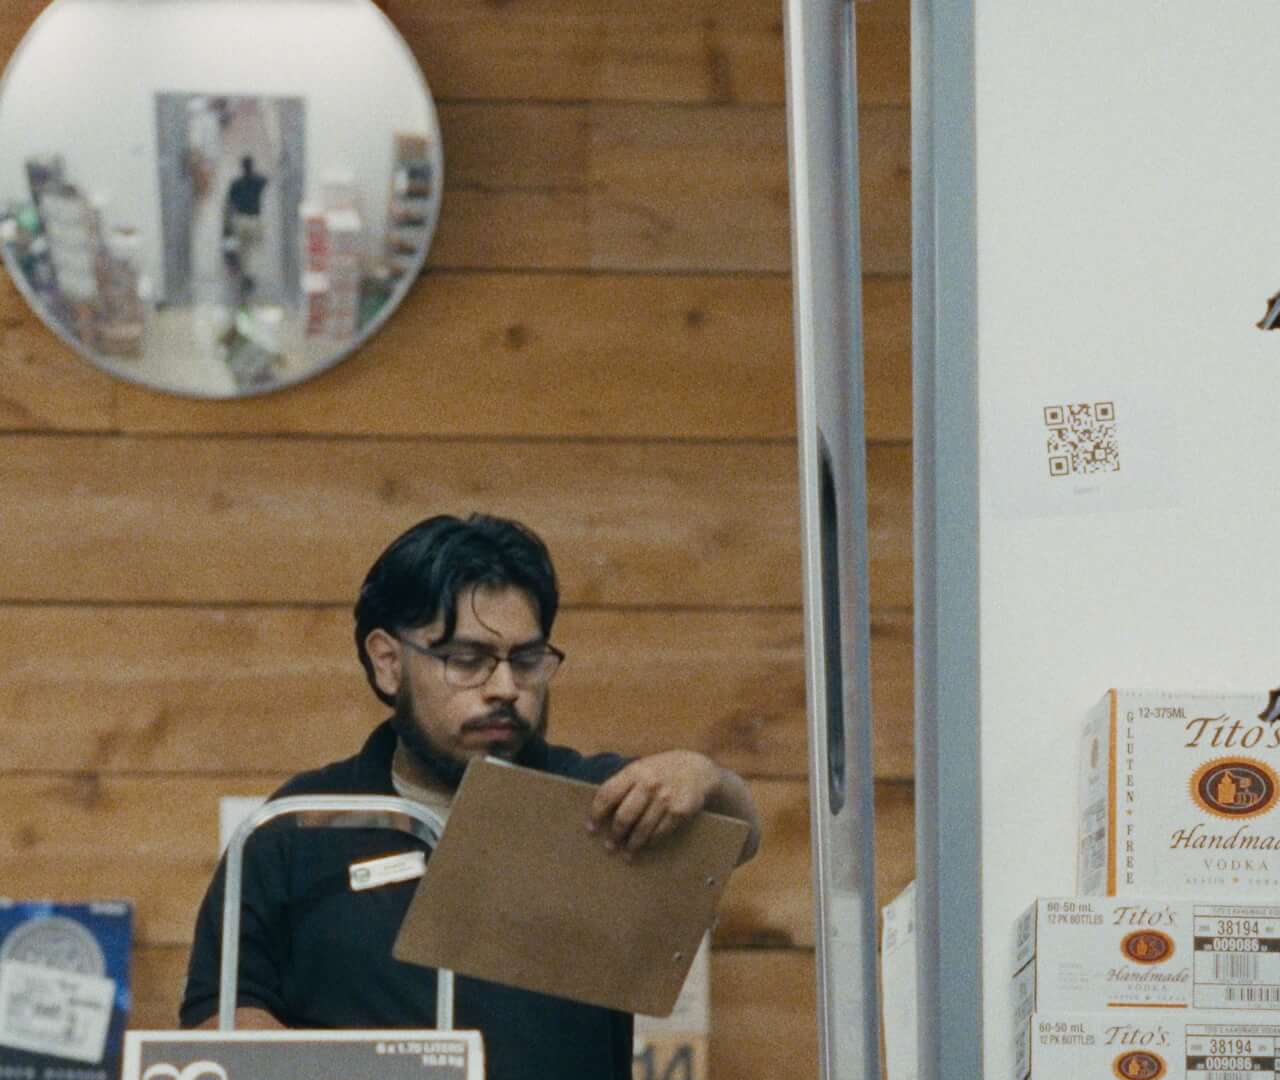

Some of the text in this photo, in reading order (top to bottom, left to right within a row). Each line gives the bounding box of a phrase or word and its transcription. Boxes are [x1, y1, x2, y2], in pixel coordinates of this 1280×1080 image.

[1138, 707, 1186, 719] 12-375ML
[1126, 711, 1135, 884] GLUTEN FREE
[1204, 859, 1269, 871] VODKA
[1113, 904, 1179, 926] Tito's
[1217, 920, 1259, 935] 38194
[1213, 938, 1260, 951] 009086
[1107, 965, 1190, 983] Handmade
[1104, 1025, 1171, 1047] Tito's
[1210, 1039, 1252, 1054] 38194
[1206, 1057, 1252, 1070] 009086
